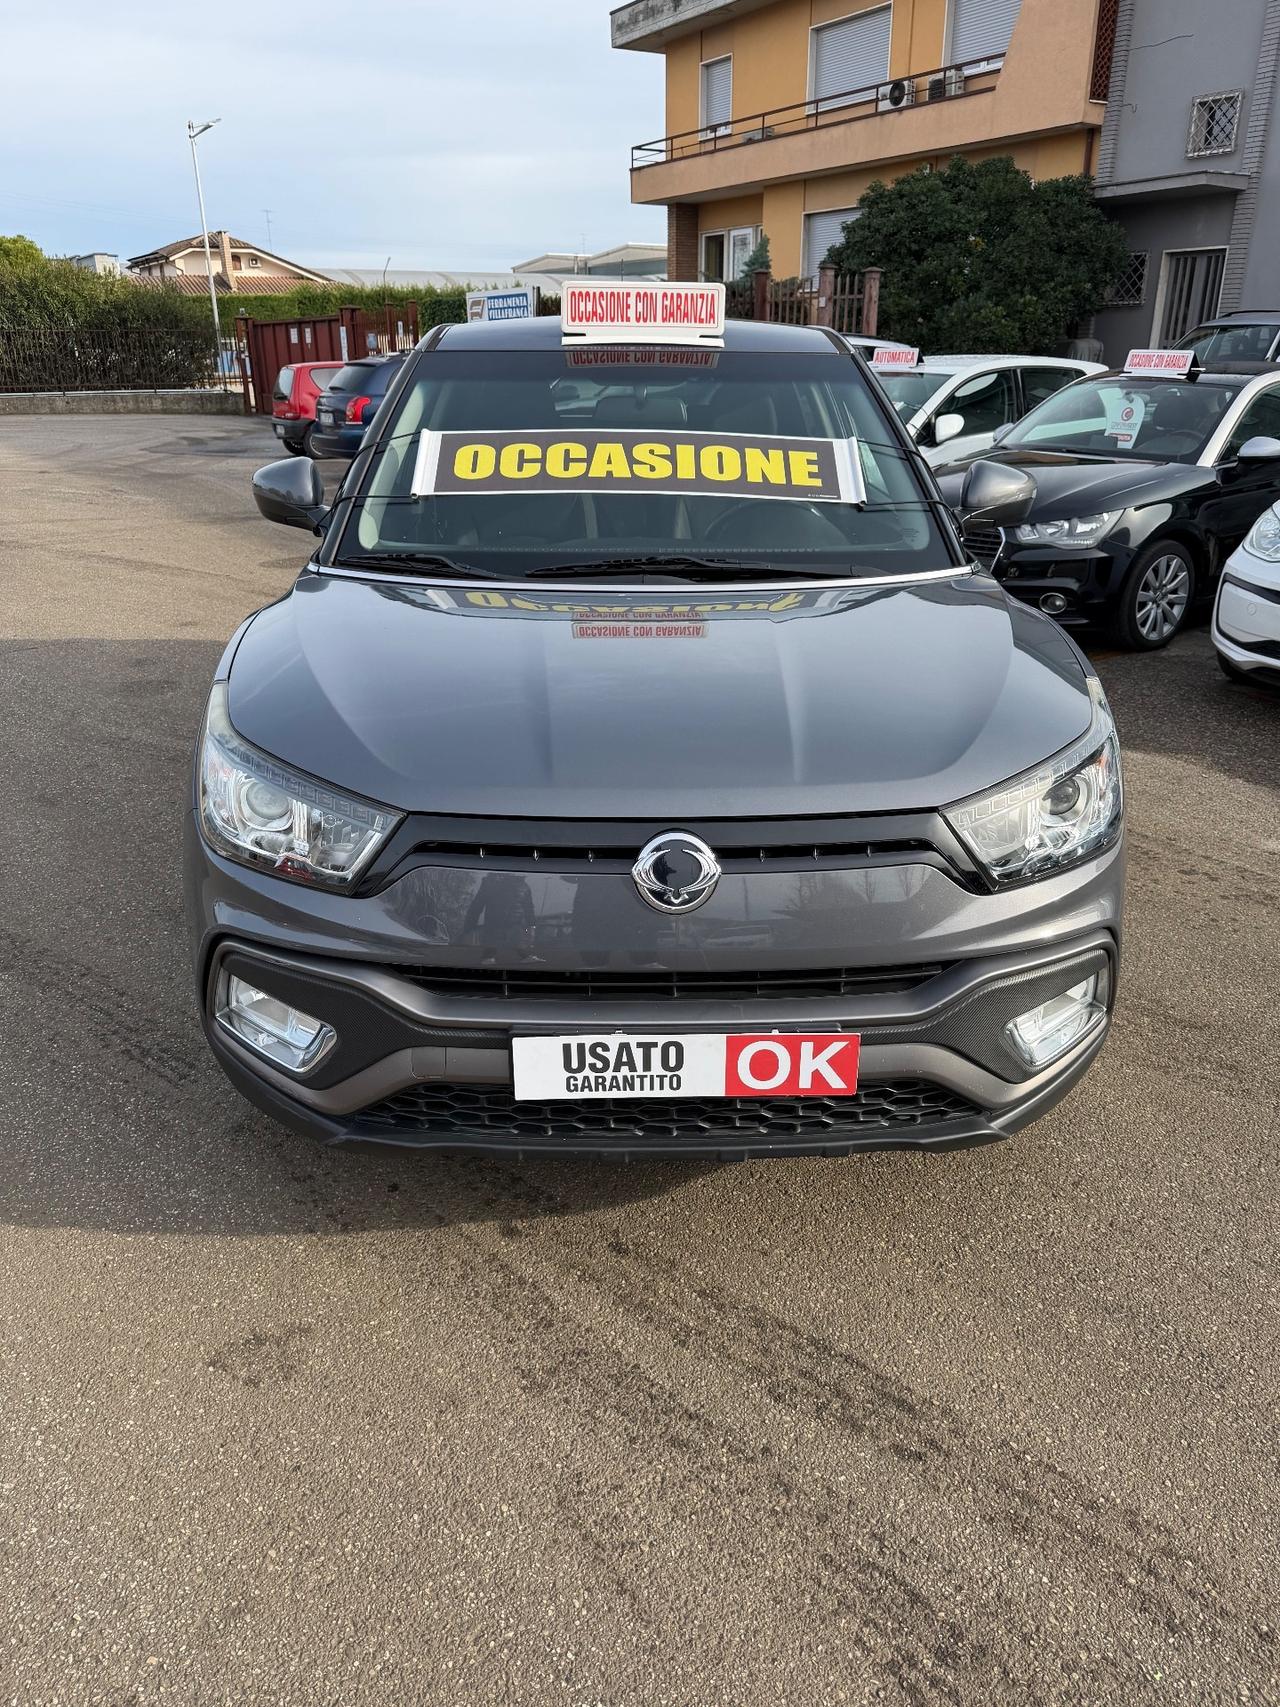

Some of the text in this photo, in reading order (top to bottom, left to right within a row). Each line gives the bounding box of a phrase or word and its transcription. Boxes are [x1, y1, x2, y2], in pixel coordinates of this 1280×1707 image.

[488, 296, 527, 309] FERRAMENTA
[570, 291, 716, 324] OCCASIONE CON GARANZIA
[489, 307, 528, 319] VILLAFRANCA
[874, 351, 915, 363] AUTOMATICA
[1129, 353, 1189, 368] OCCASIONE CON GARANZIA
[453, 442, 823, 487] OCCASIONE
[562, 1041, 684, 1074] USATO
[737, 1040, 850, 1090] OK
[565, 1074, 682, 1093] GARANTITO
